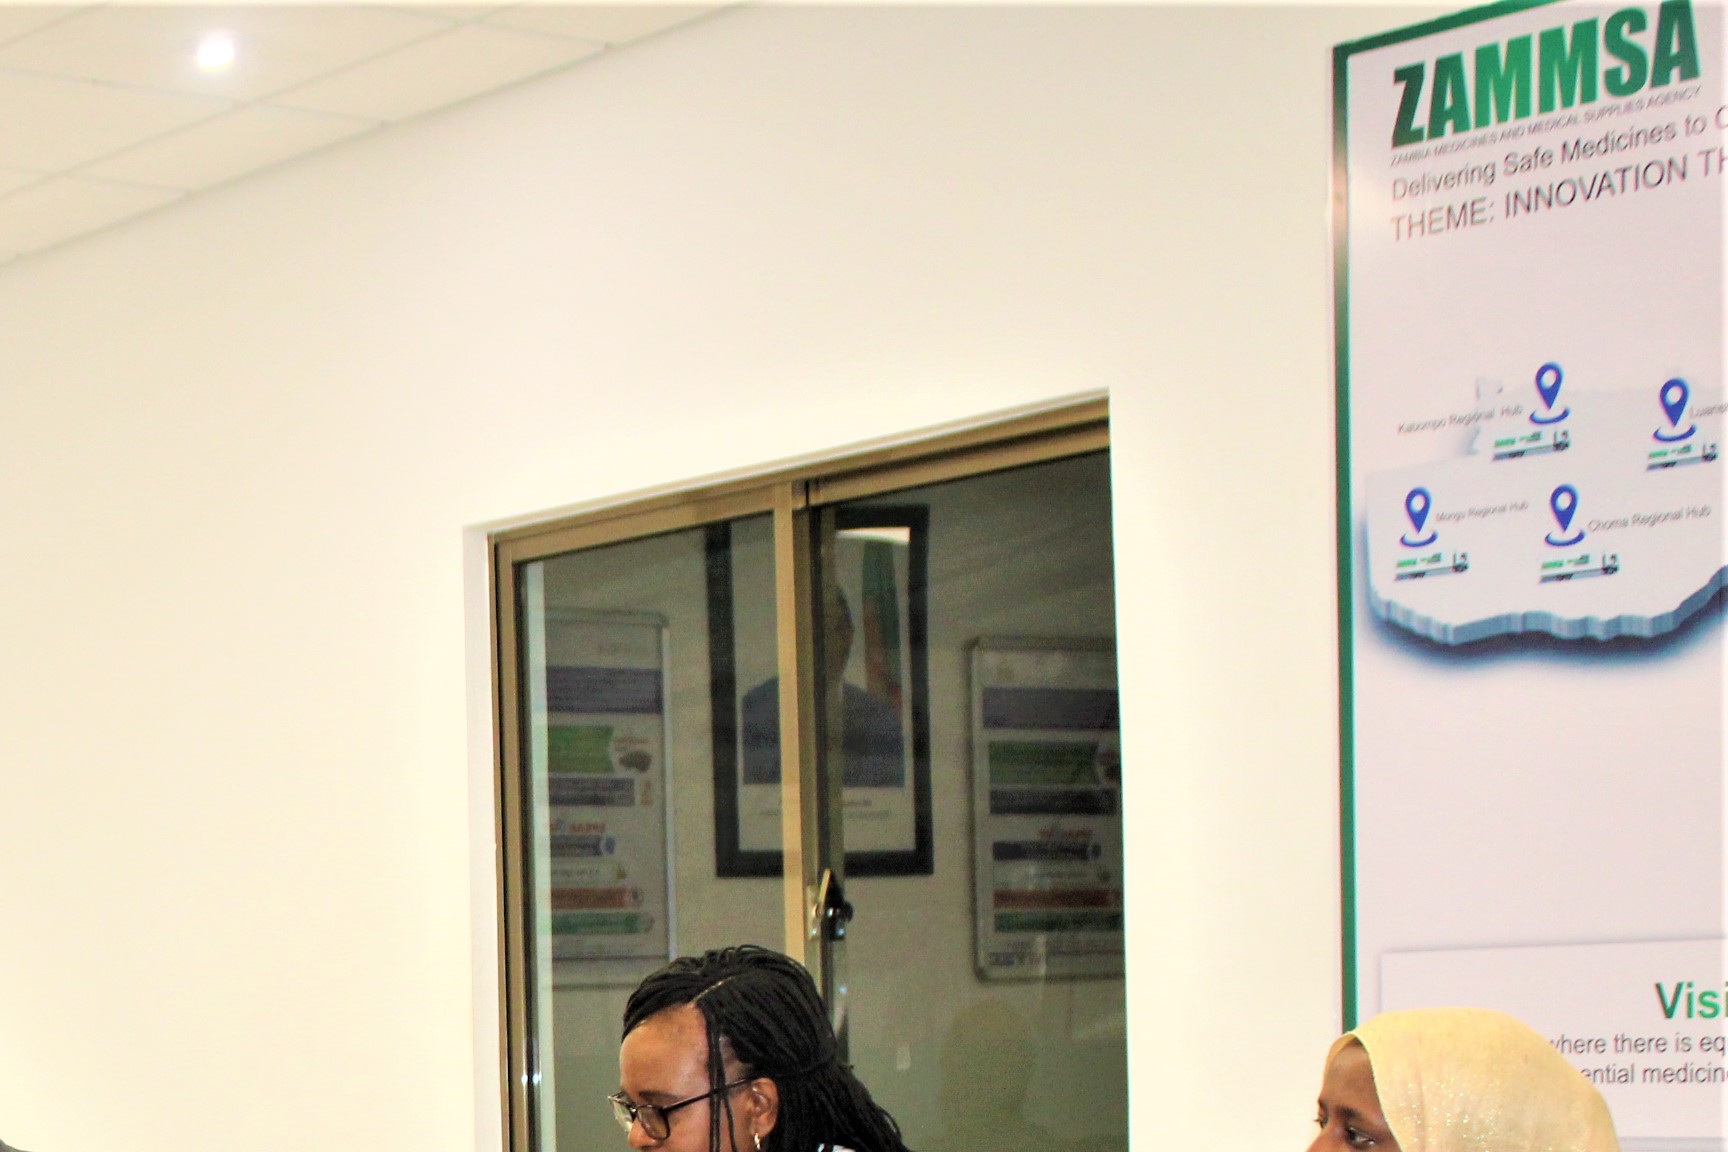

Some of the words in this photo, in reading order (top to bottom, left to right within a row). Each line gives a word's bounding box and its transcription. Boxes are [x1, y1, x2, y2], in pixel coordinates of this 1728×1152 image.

[1390, 0, 1702, 149] ZAMMSA
[1433, 132, 1497, 157] MEDICINES
[1499, 126, 1526, 143] AND
[1528, 114, 1578, 136] MEDICAL
[1583, 98, 1645, 123] SUPPLIES
[1646, 85, 1702, 109] AGENCY
[1393, 162, 1496, 201] Delivering
[1503, 146, 1554, 176] Safe
[1561, 122, 1677, 164] Medicines
[1685, 114, 1707, 137] to
[1391, 196, 1495, 242] THEME:
[1505, 153, 1688, 219] INNOVATION
[1448, 408, 1496, 426] Regional
[1500, 404, 1523, 417] Hub
[1631, 508, 1684, 528] Regional
[1685, 504, 1712, 520] Hub
[1614, 1032, 1668, 1054] there
[1675, 1032, 1693, 1052] is
[1581, 1063, 1635, 1084] ential
[1642, 1062, 1728, 1083] medicin
